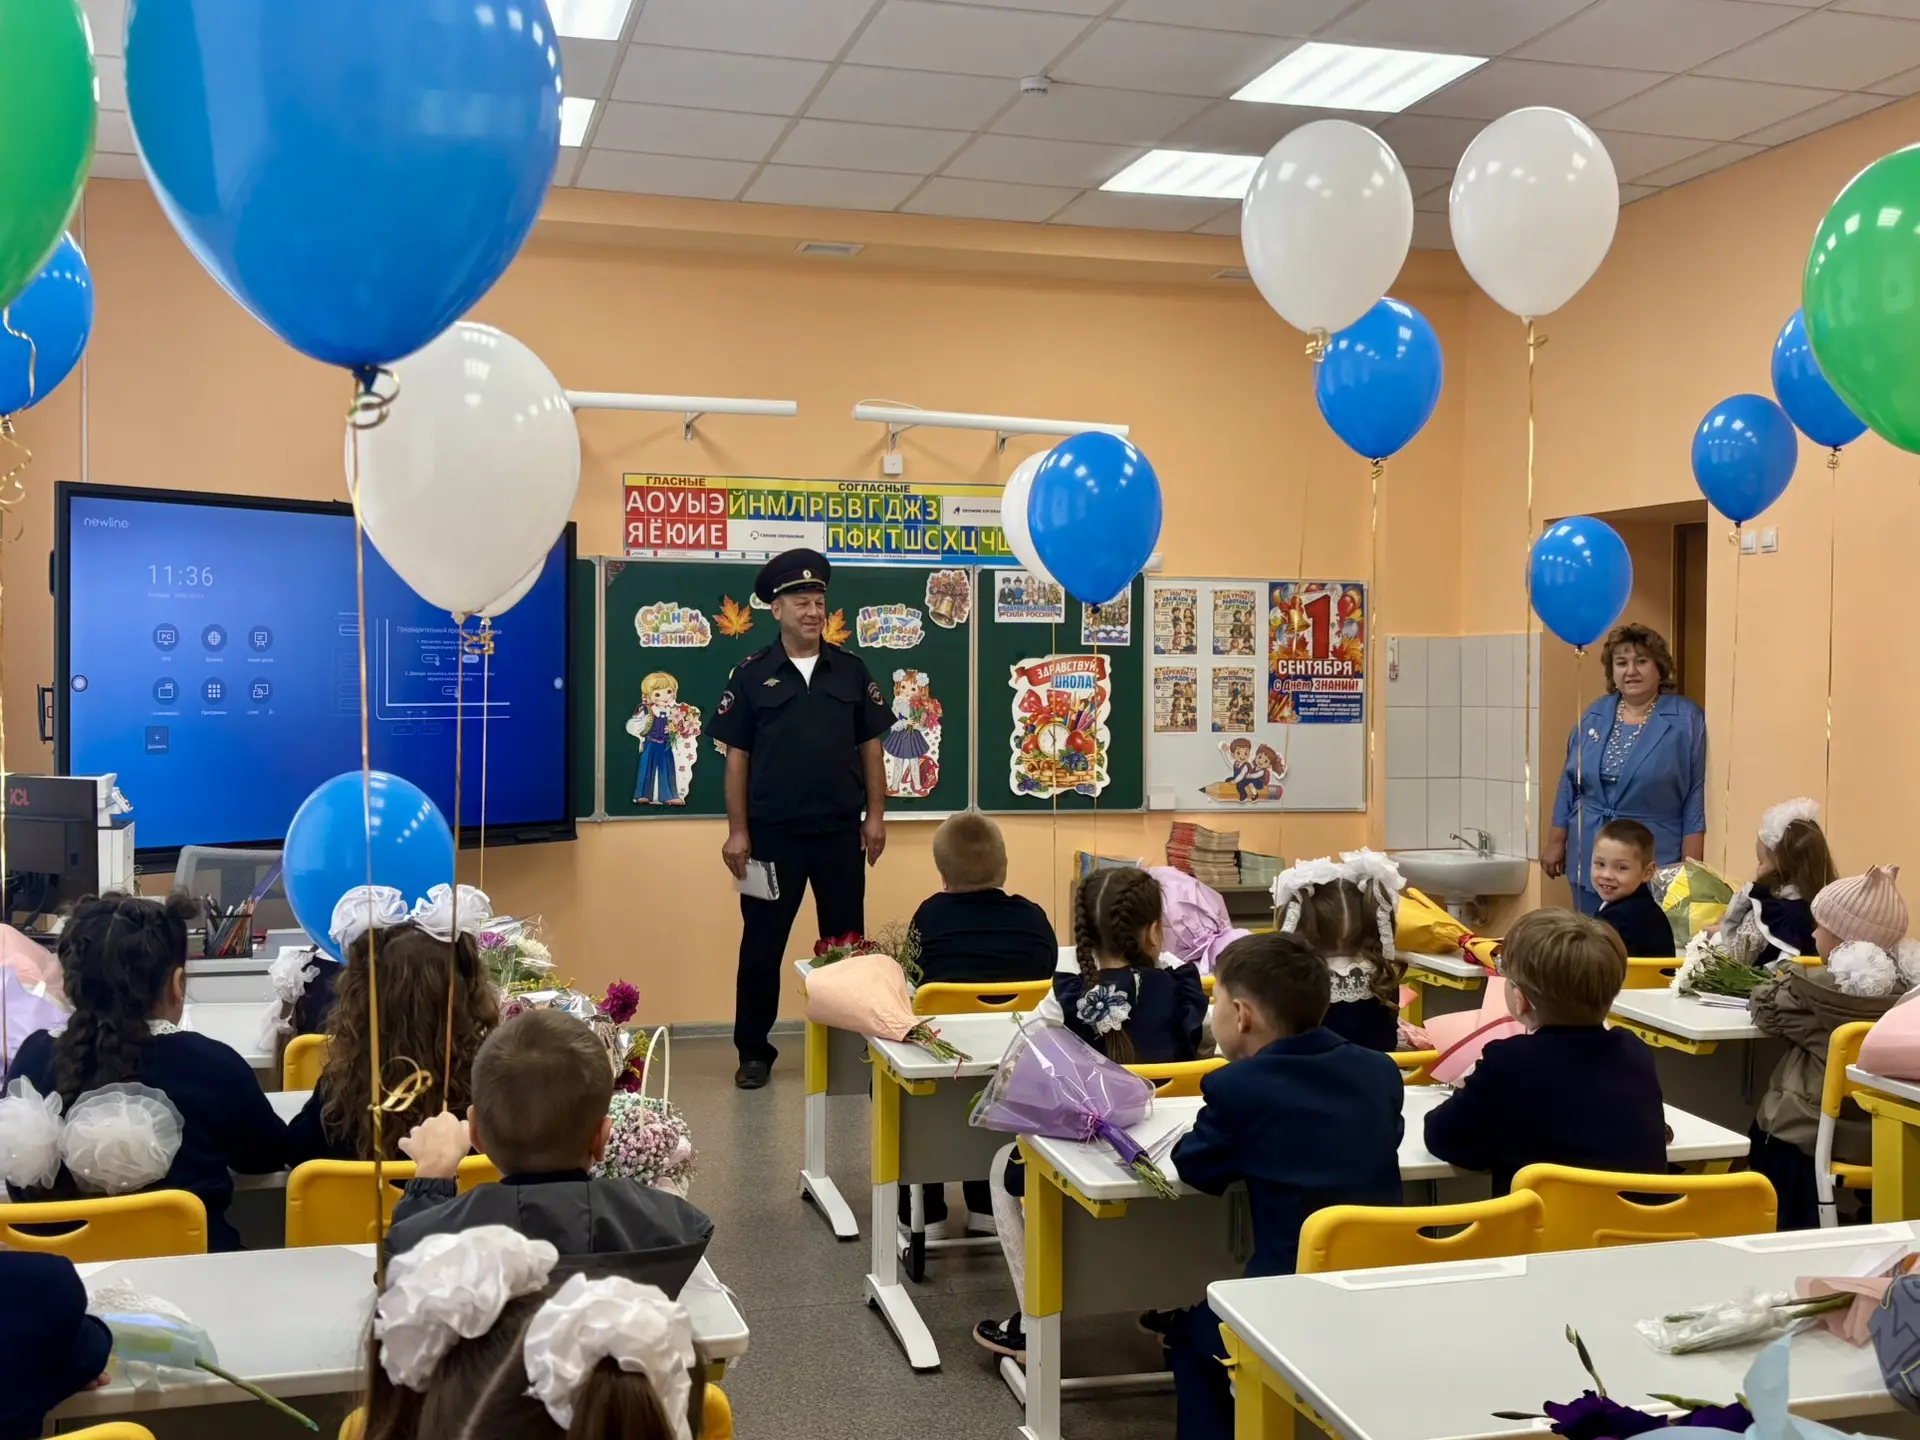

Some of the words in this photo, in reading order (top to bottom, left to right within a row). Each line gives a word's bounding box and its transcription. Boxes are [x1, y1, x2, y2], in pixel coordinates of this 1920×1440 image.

[646, 476, 706, 487] ГЛАСНЫЕ
[838, 482, 911, 493] СОГЛАСНЫЕ
[84, 516, 129, 529] newline
[148, 564, 214, 587] 11:36
[1304, 593, 1331, 660] 1
[1278, 660, 1353, 676] СЕНТЯБРЯ
